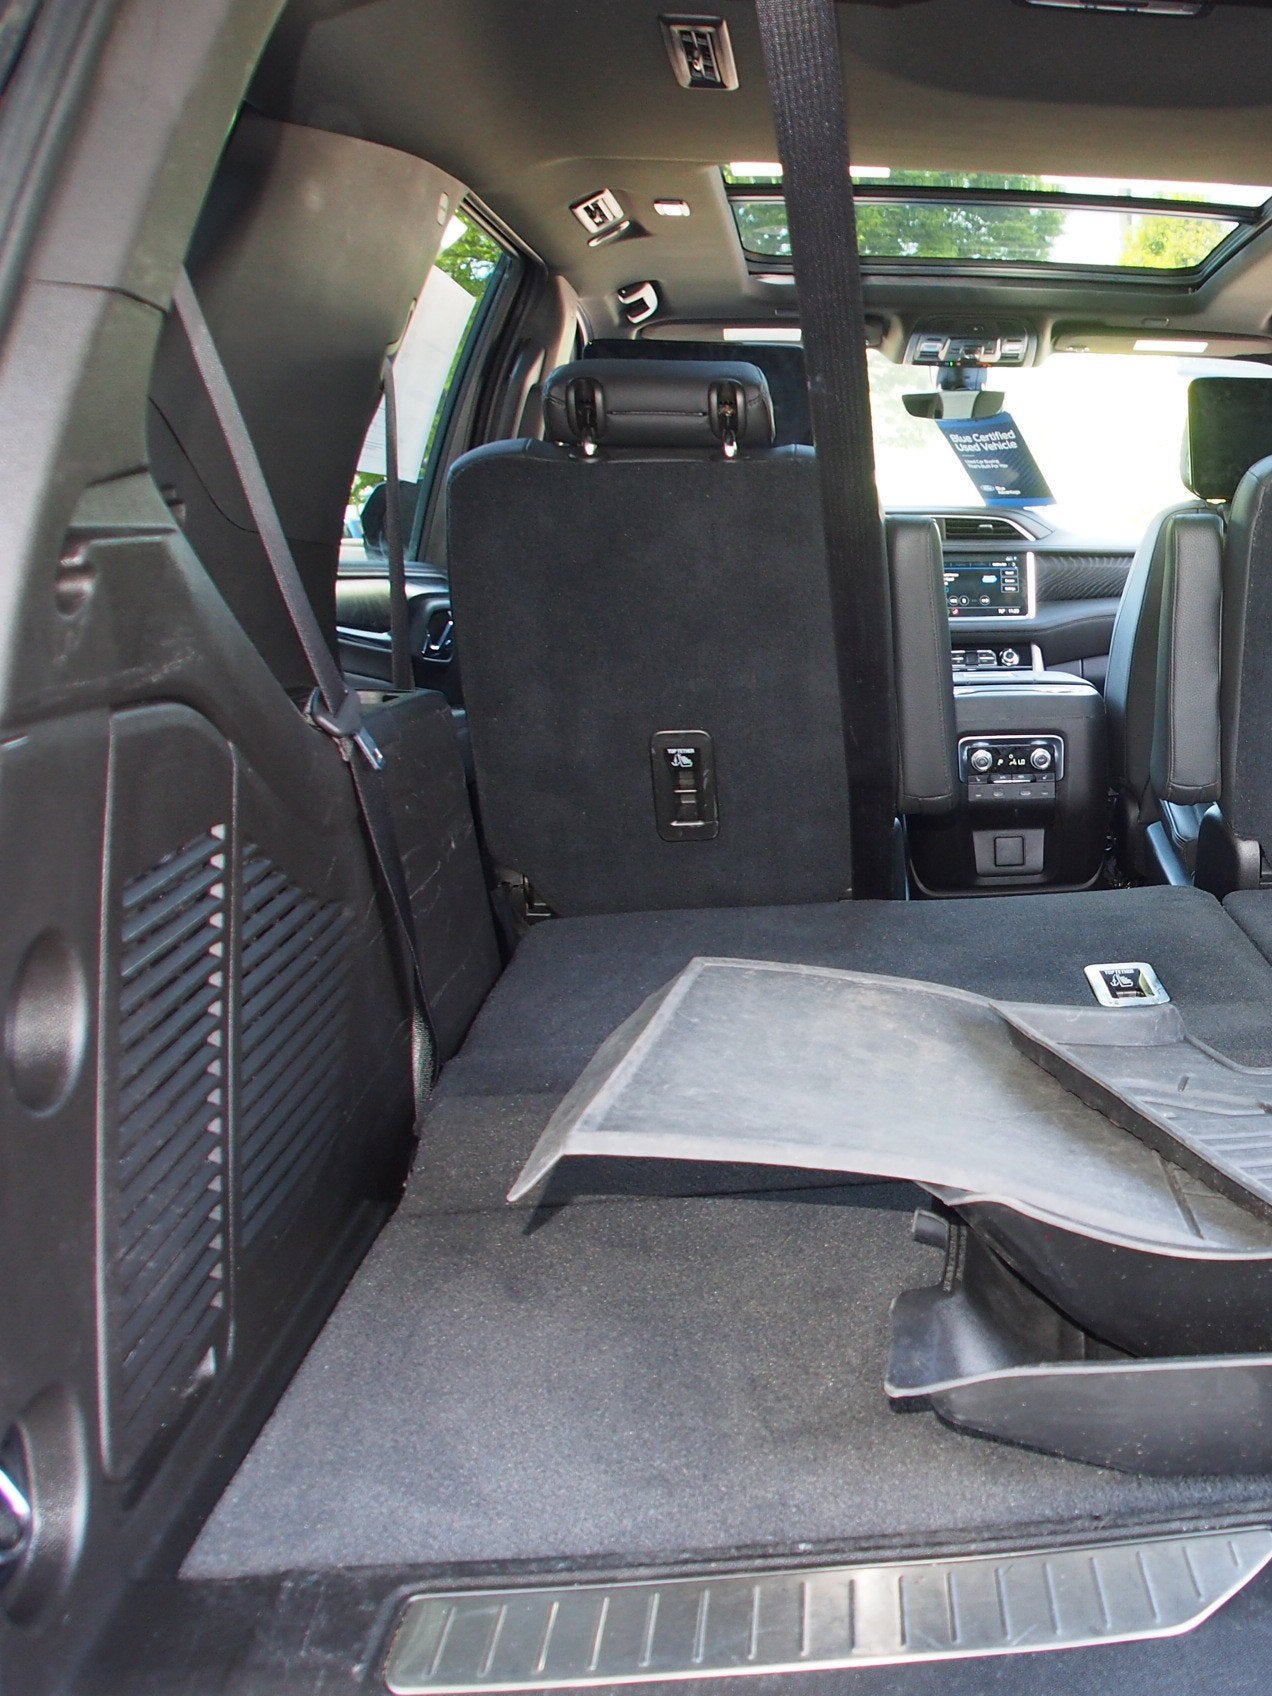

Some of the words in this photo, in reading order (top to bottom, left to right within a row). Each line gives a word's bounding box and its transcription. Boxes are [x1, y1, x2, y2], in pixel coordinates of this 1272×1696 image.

[949, 434, 973, 443] Blue
[972, 429, 1016, 442] Certified
[954, 442, 981, 452] Used
[980, 440, 1018, 451] Vehicle
